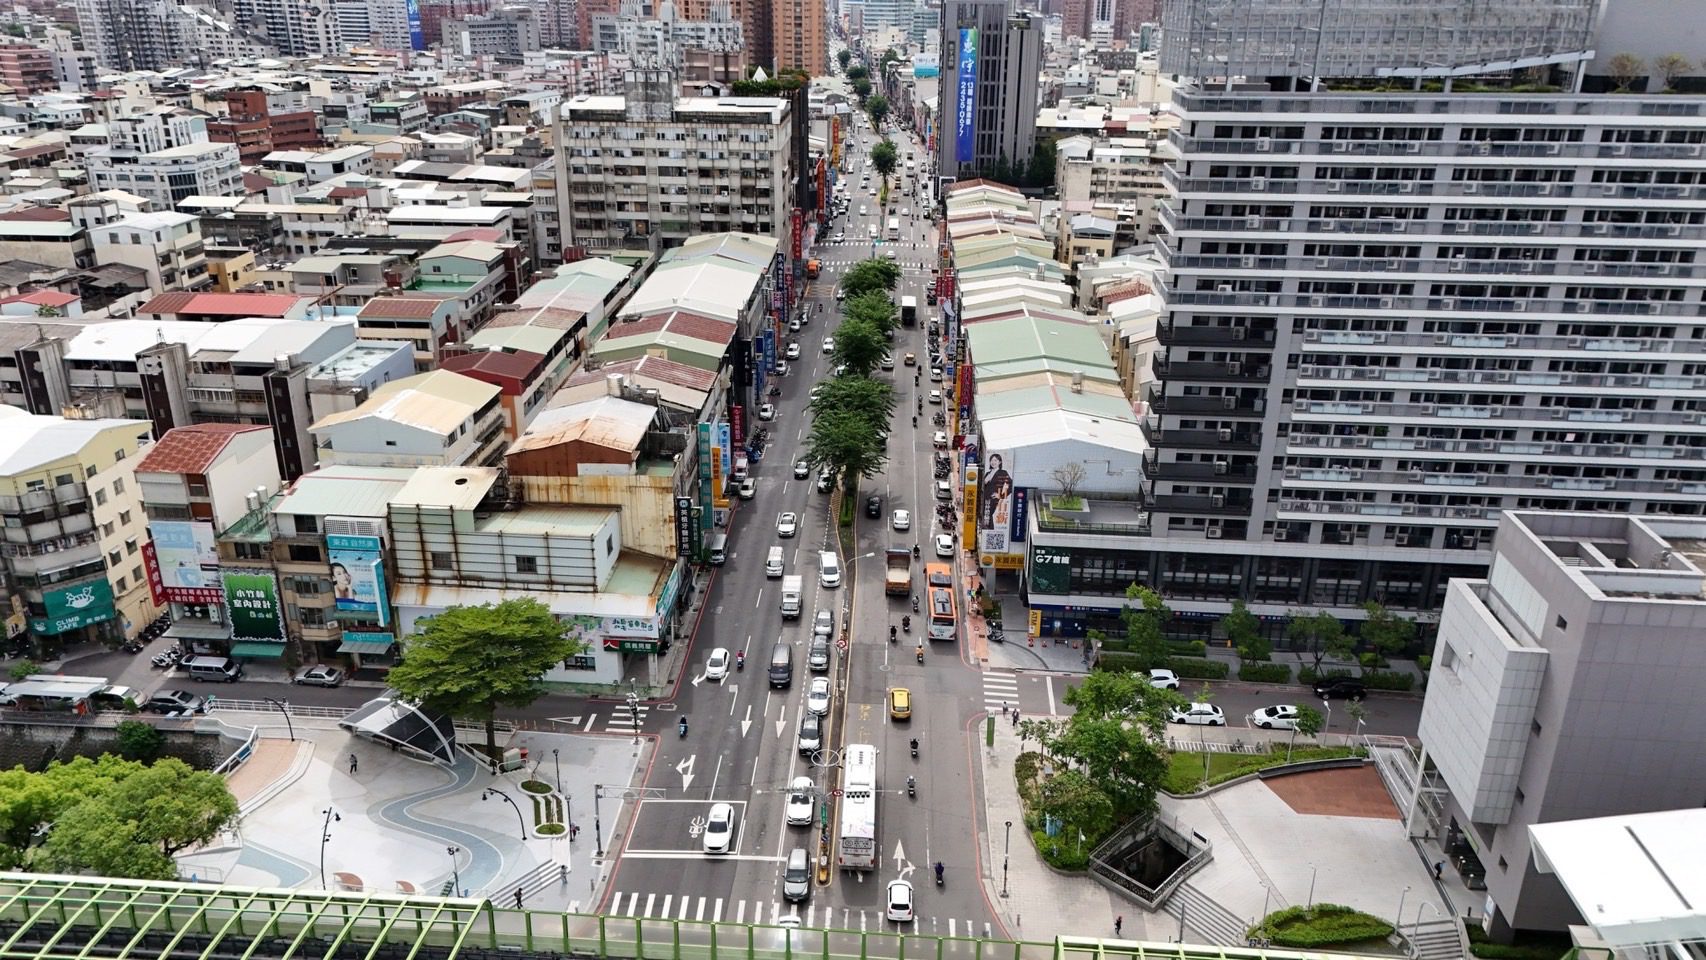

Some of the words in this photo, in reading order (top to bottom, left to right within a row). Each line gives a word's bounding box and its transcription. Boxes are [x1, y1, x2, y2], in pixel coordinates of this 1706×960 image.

[233, 600, 271, 608] 室內設計
[56, 616, 79, 626] CLIMB
[58, 623, 78, 631] CAFE
